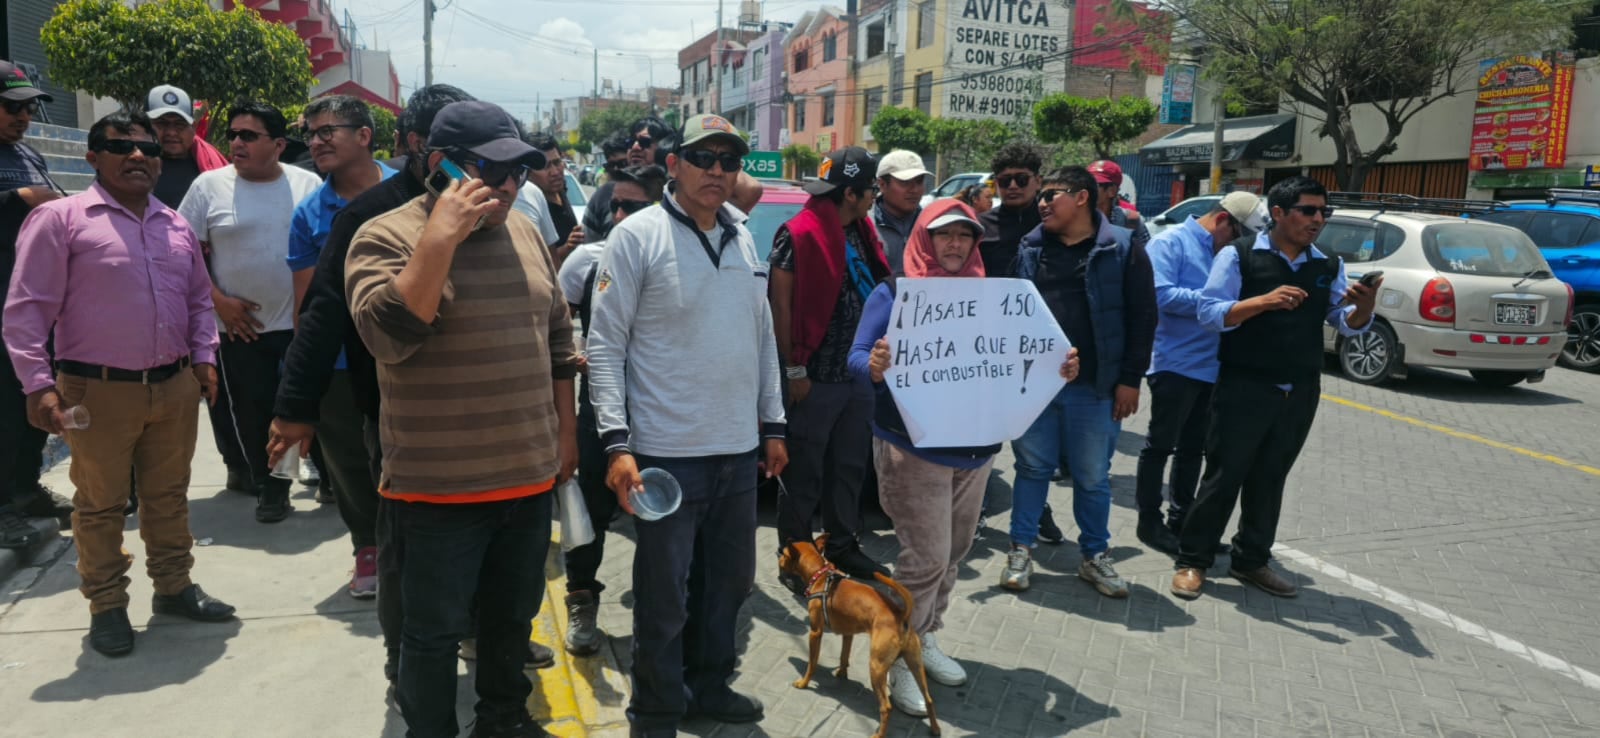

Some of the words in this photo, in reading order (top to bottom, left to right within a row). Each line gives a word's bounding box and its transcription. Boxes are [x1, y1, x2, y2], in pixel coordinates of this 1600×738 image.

[962, 0, 1049, 27] AVITCA
[956, 26, 1010, 47] SEPARE
[1014, 33, 1058, 52] LOTES
[965, 48, 995, 66] CON
[1000, 293, 1036, 317] 1.50
[894, 336, 957, 367] HASTA
[974, 335, 1008, 355] QUE
[1018, 334, 1056, 355] BAJE
[896, 374, 911, 389] EL
[922, 359, 1016, 384] COMBUSTIBLE
